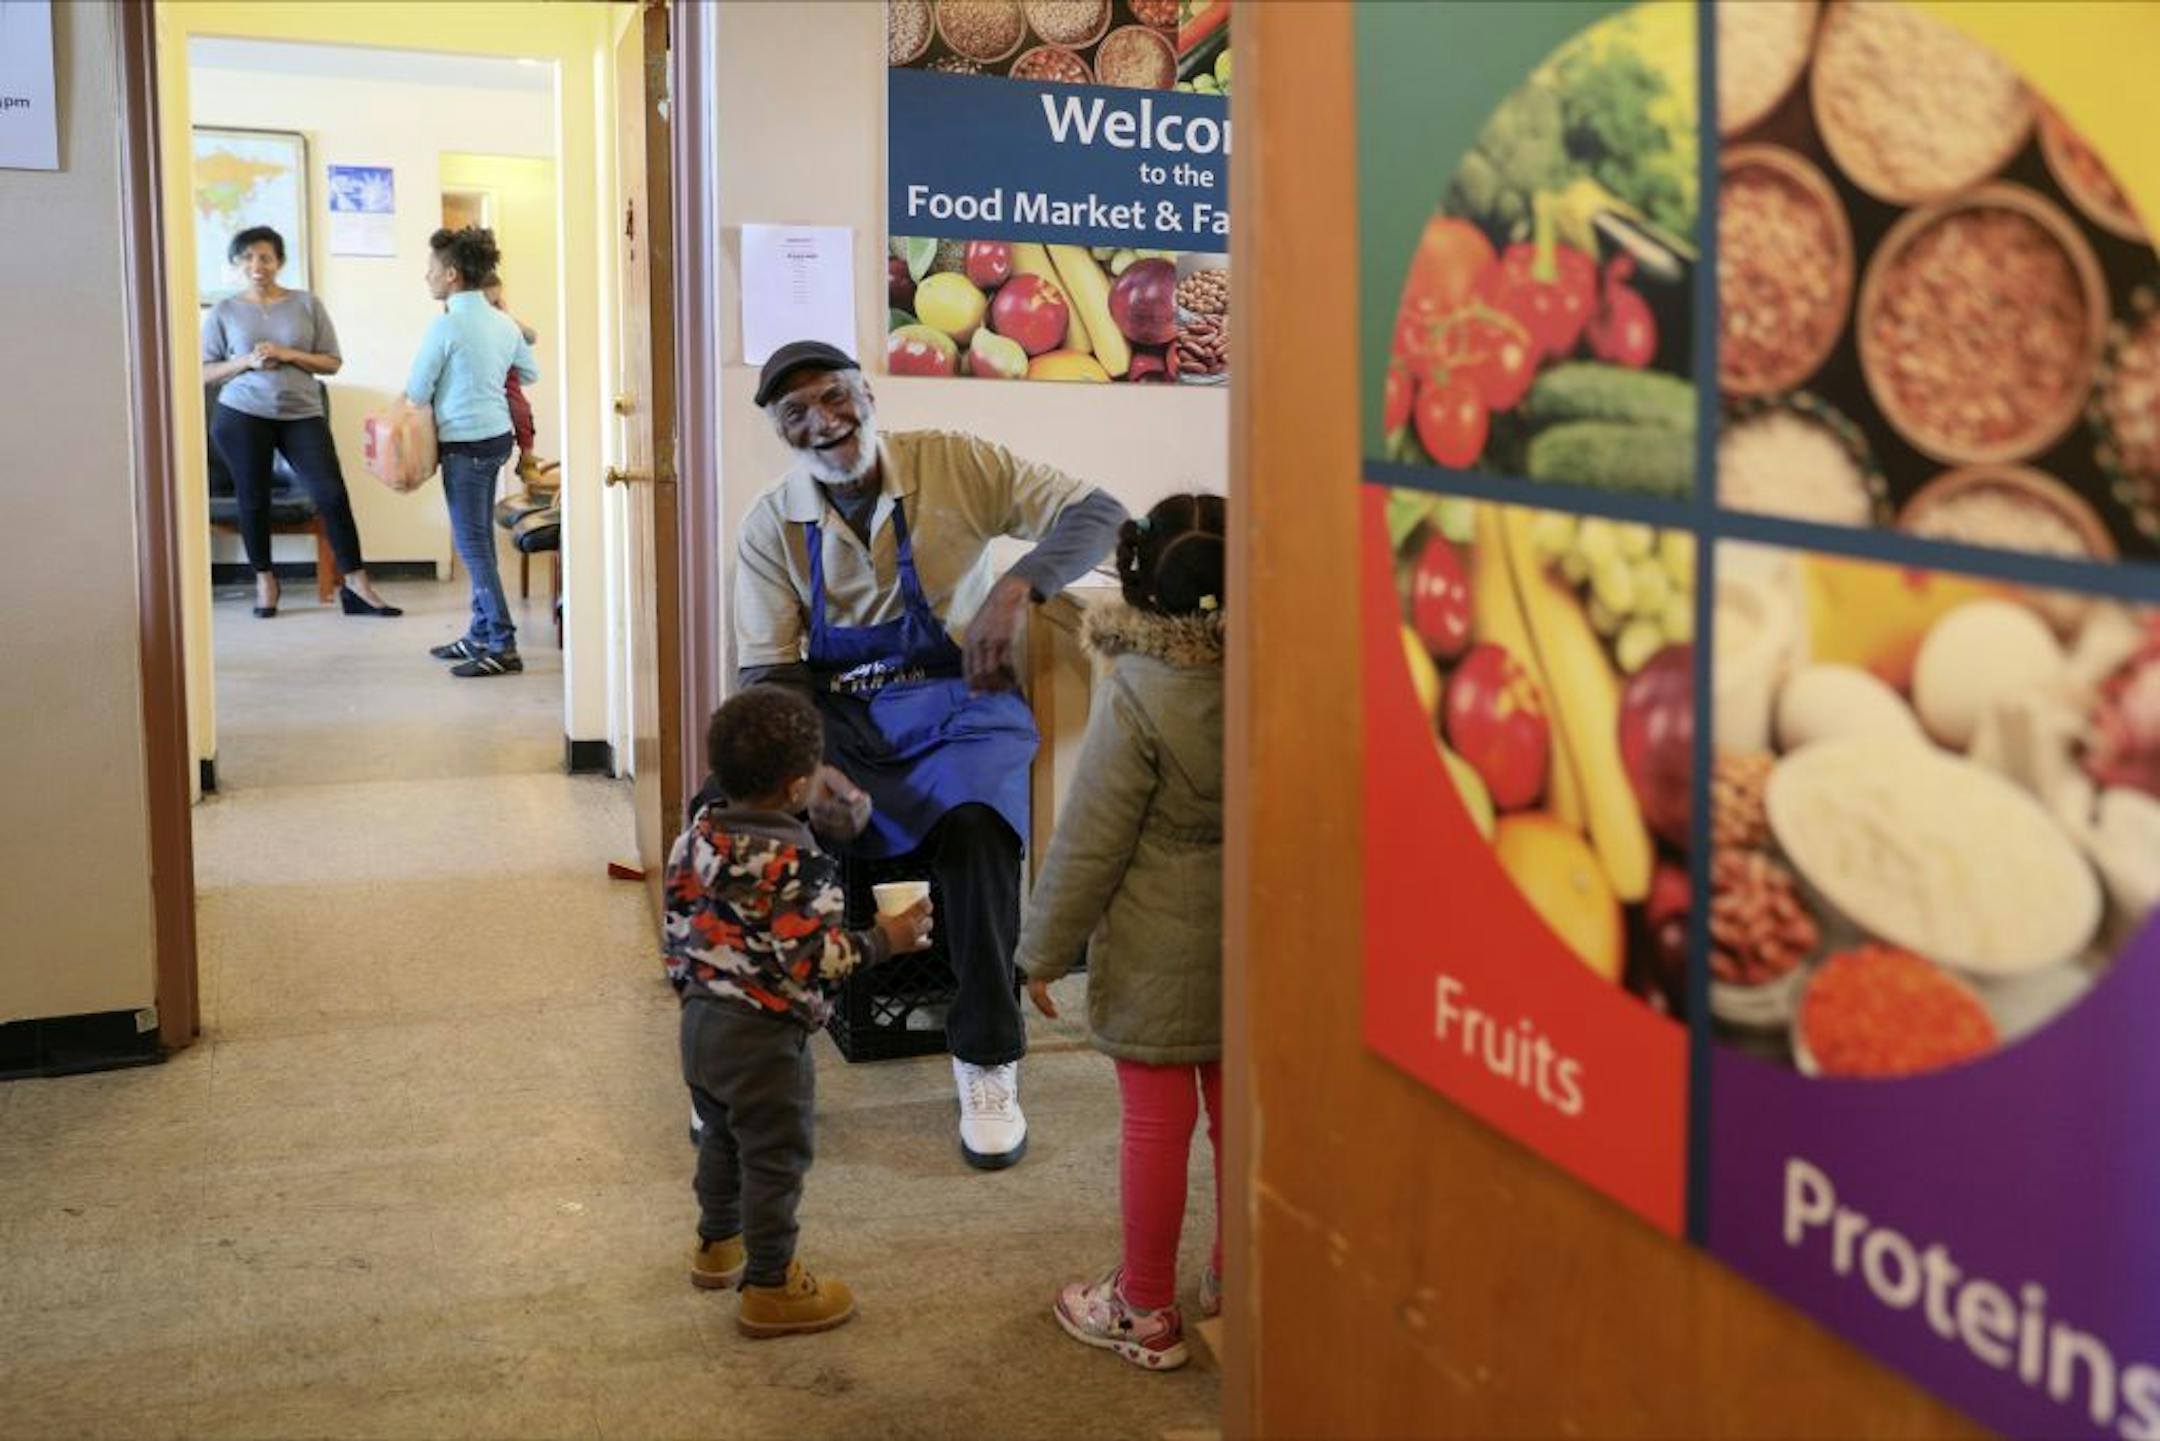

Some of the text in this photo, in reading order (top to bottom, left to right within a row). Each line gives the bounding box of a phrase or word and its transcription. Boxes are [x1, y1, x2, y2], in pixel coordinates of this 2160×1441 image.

[1041, 94, 1231, 154] Welco
[1139, 163, 1214, 187] to the
[908, 185, 1003, 222] Food
[1013, 192, 1146, 230] Market
[1155, 201, 1183, 232] &
[1436, 974, 1583, 1117] Fruits
[1785, 1156, 2160, 1441] Proteins
